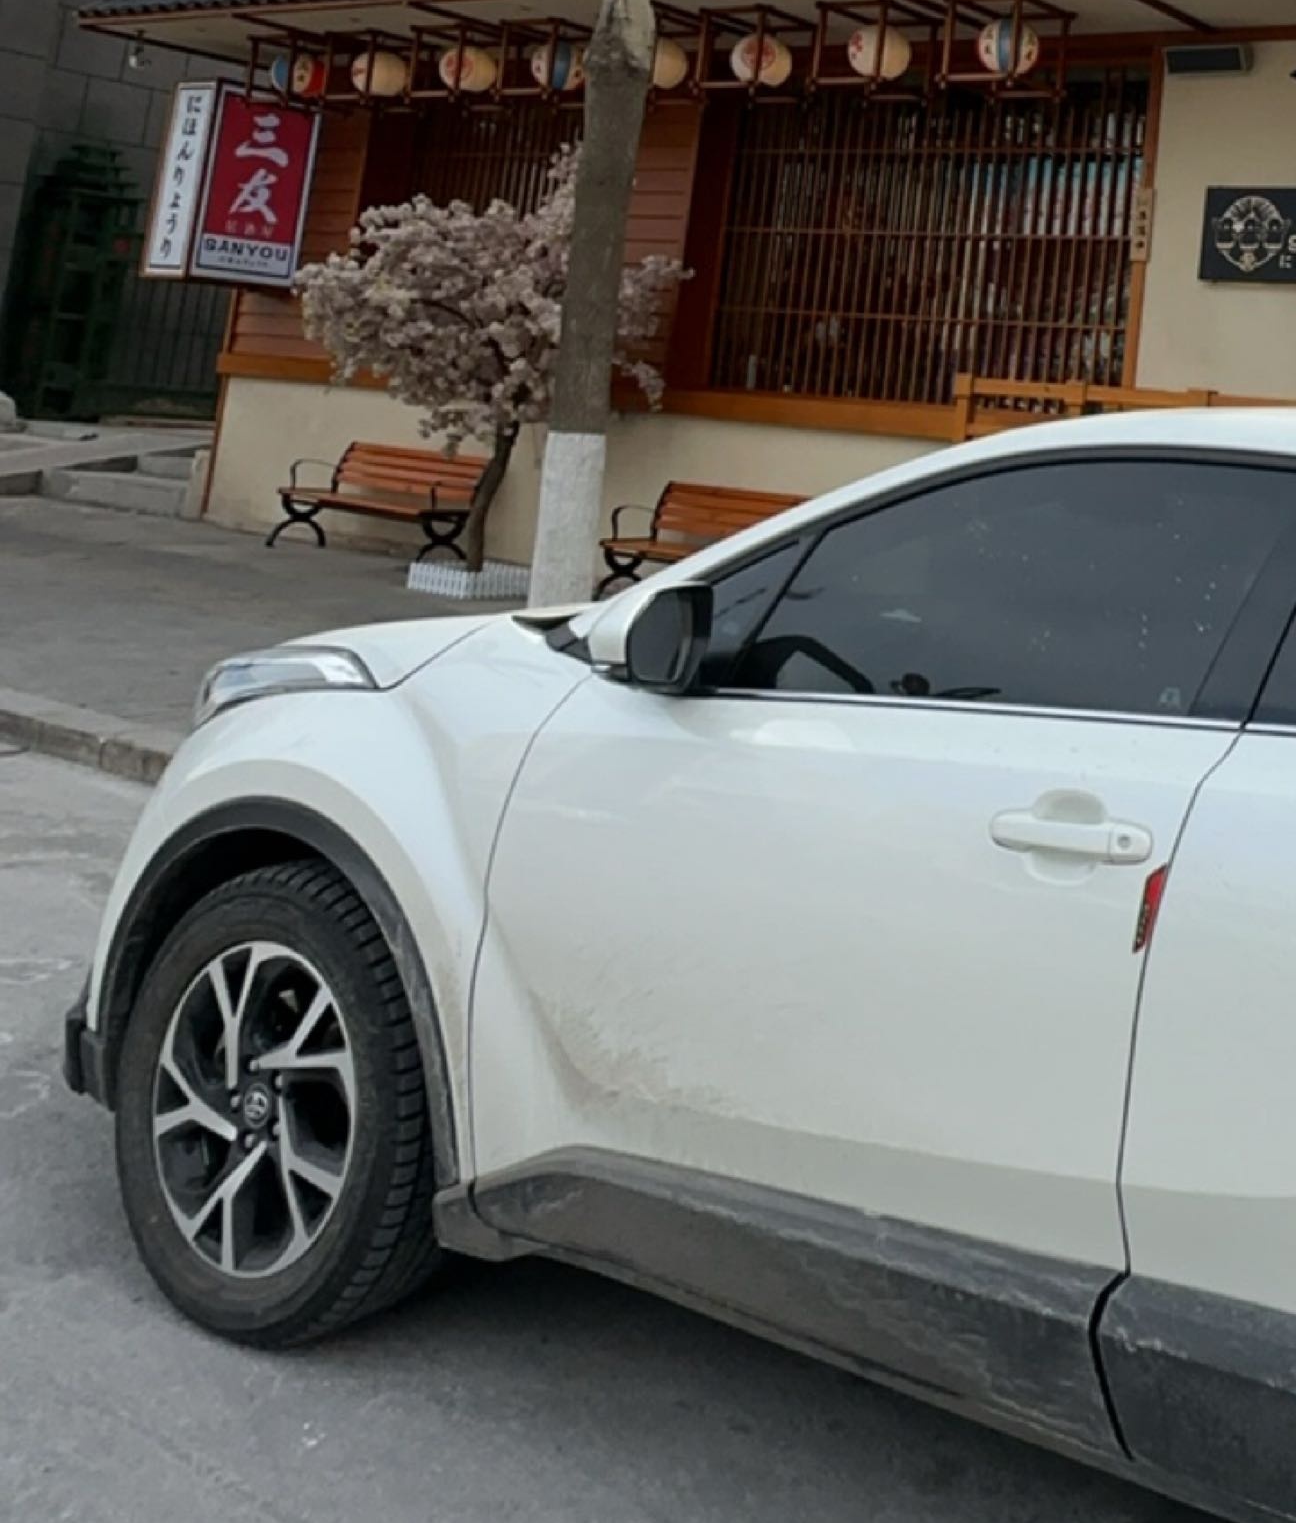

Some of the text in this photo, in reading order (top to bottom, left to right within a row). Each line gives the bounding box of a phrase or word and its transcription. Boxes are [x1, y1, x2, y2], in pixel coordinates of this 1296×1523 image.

[159, 95, 202, 258] にほんりょうり
[229, 112, 289, 223] 三友
[203, 237, 289, 262] SANYOU
